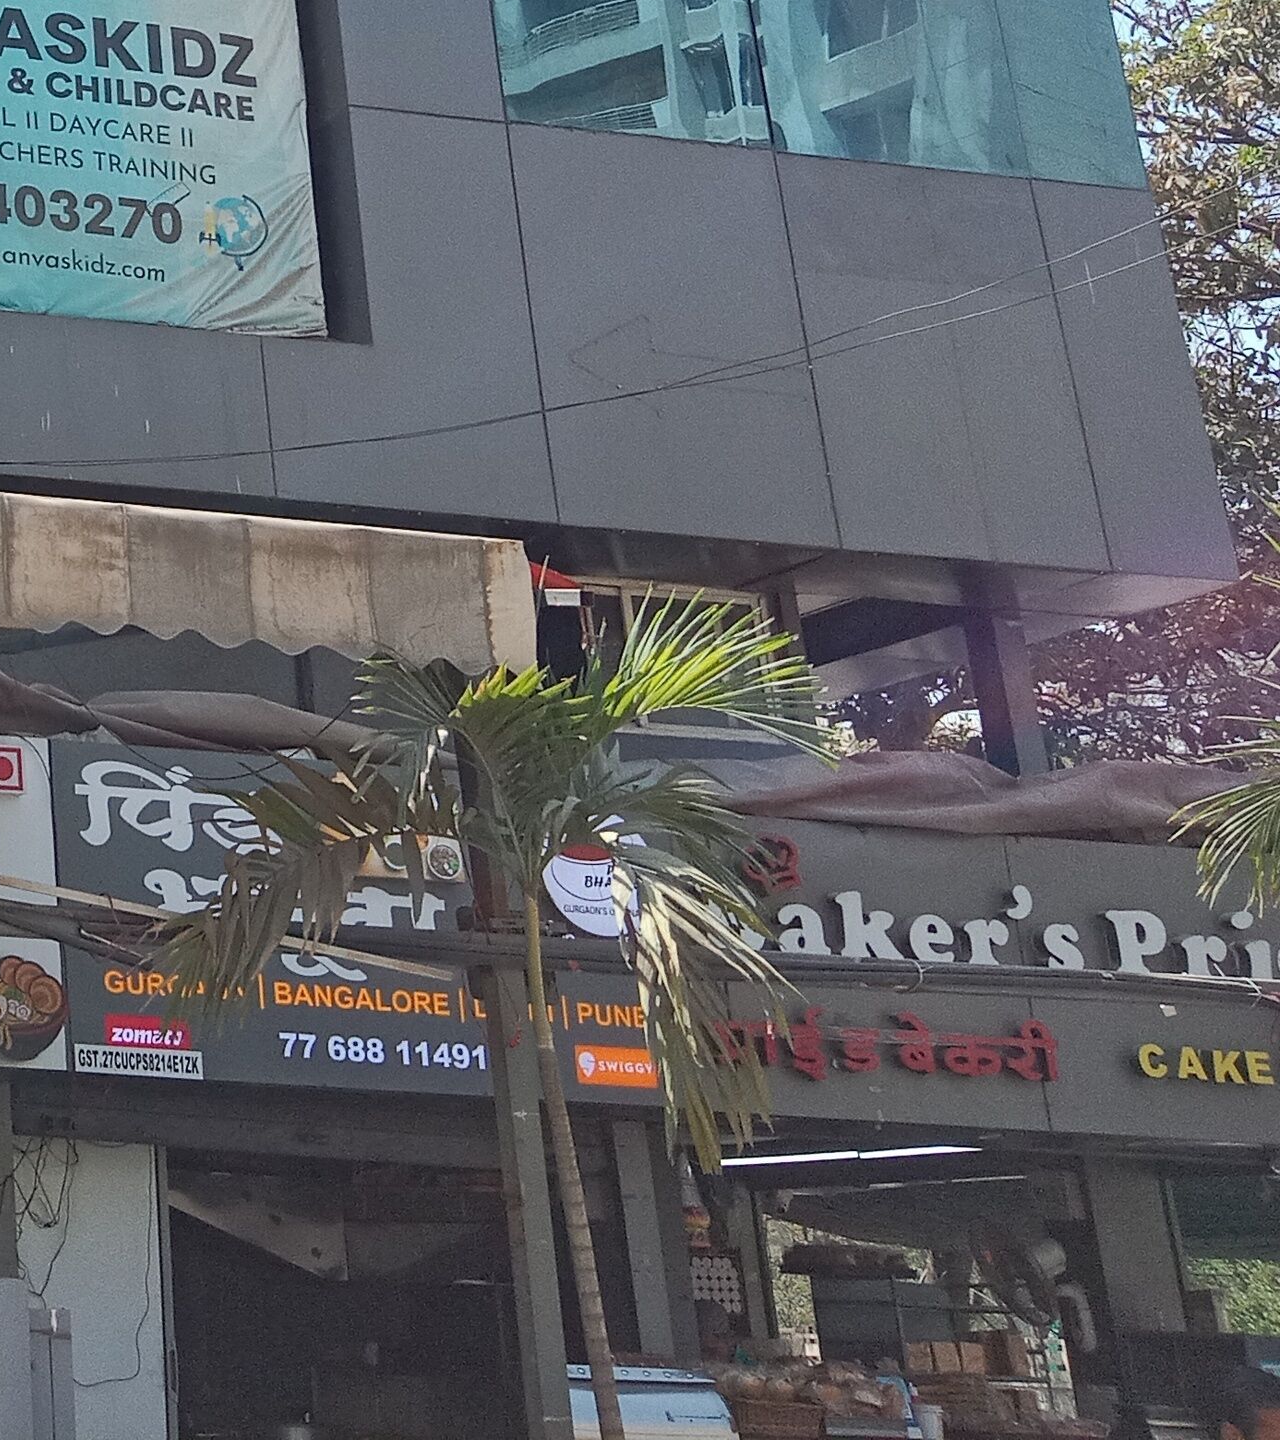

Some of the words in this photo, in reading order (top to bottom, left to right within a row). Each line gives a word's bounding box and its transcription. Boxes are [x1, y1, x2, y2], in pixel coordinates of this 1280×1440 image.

[7, 67, 35, 96] &
[45, 72, 256, 123] CHILDCARE
[49, 112, 170, 148] DAYCARE
[92, 152, 218, 187] TRAINING
[1102, 908, 1280, 980] Pri
[274, 981, 450, 1016] BANGALORE
[278, 1032, 317, 1059] 77
[327, 1035, 384, 1063] 688
[394, 1039, 487, 1070] 11491
[896, 1010, 1059, 1083] बेकरी
[1138, 1042, 1275, 1086] CAKE
[597, 1060, 653, 1075] SWIGGY
